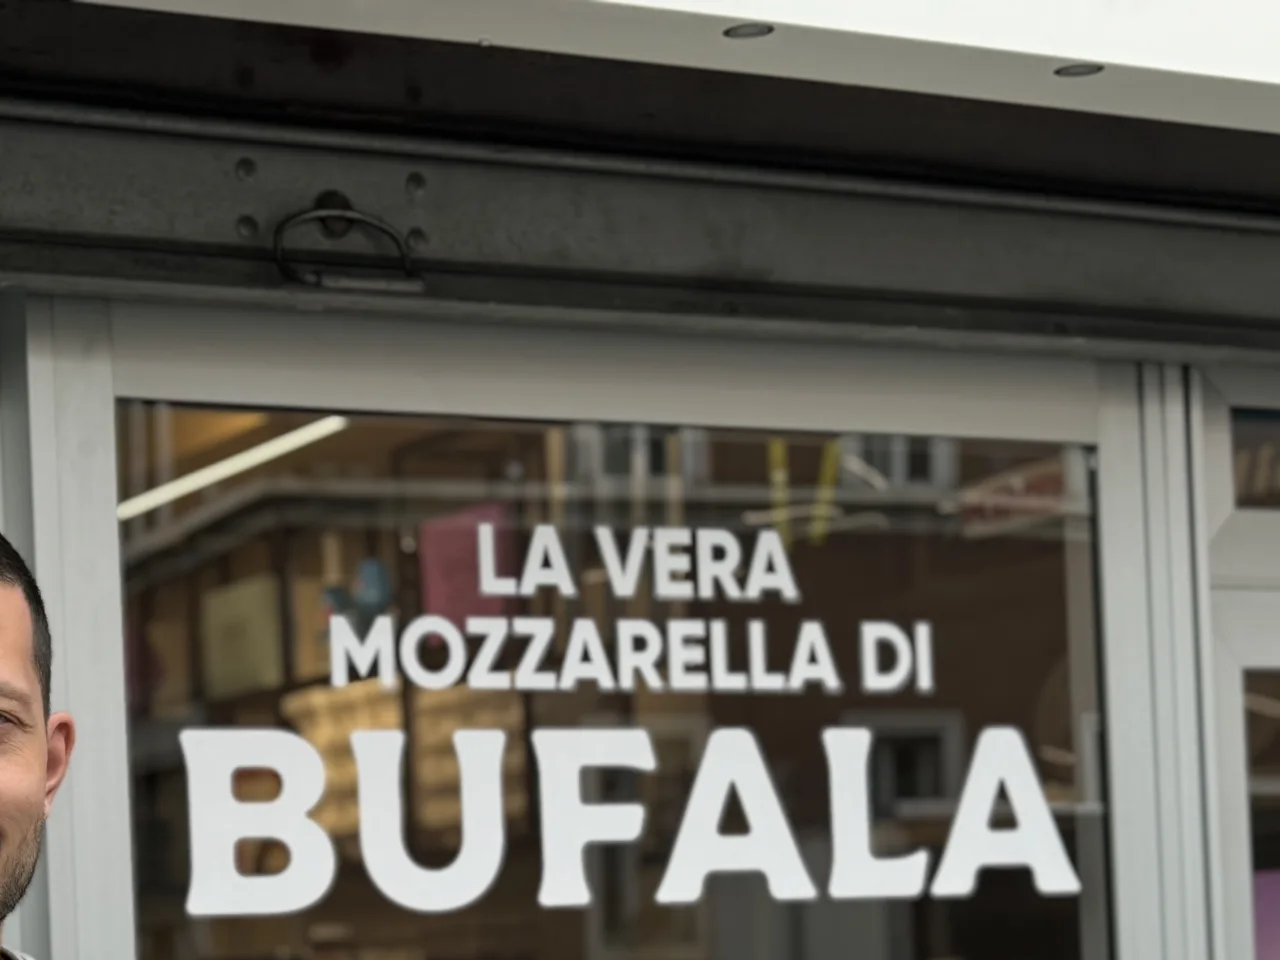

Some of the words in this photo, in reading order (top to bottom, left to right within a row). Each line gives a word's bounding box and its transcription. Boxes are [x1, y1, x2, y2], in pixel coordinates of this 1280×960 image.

[478, 523, 576, 597] LA
[596, 526, 798, 600] VERA
[328, 614, 841, 693] MOZZARELLA
[861, 621, 933, 692] DI
[179, 727, 1081, 916] BUFALA
